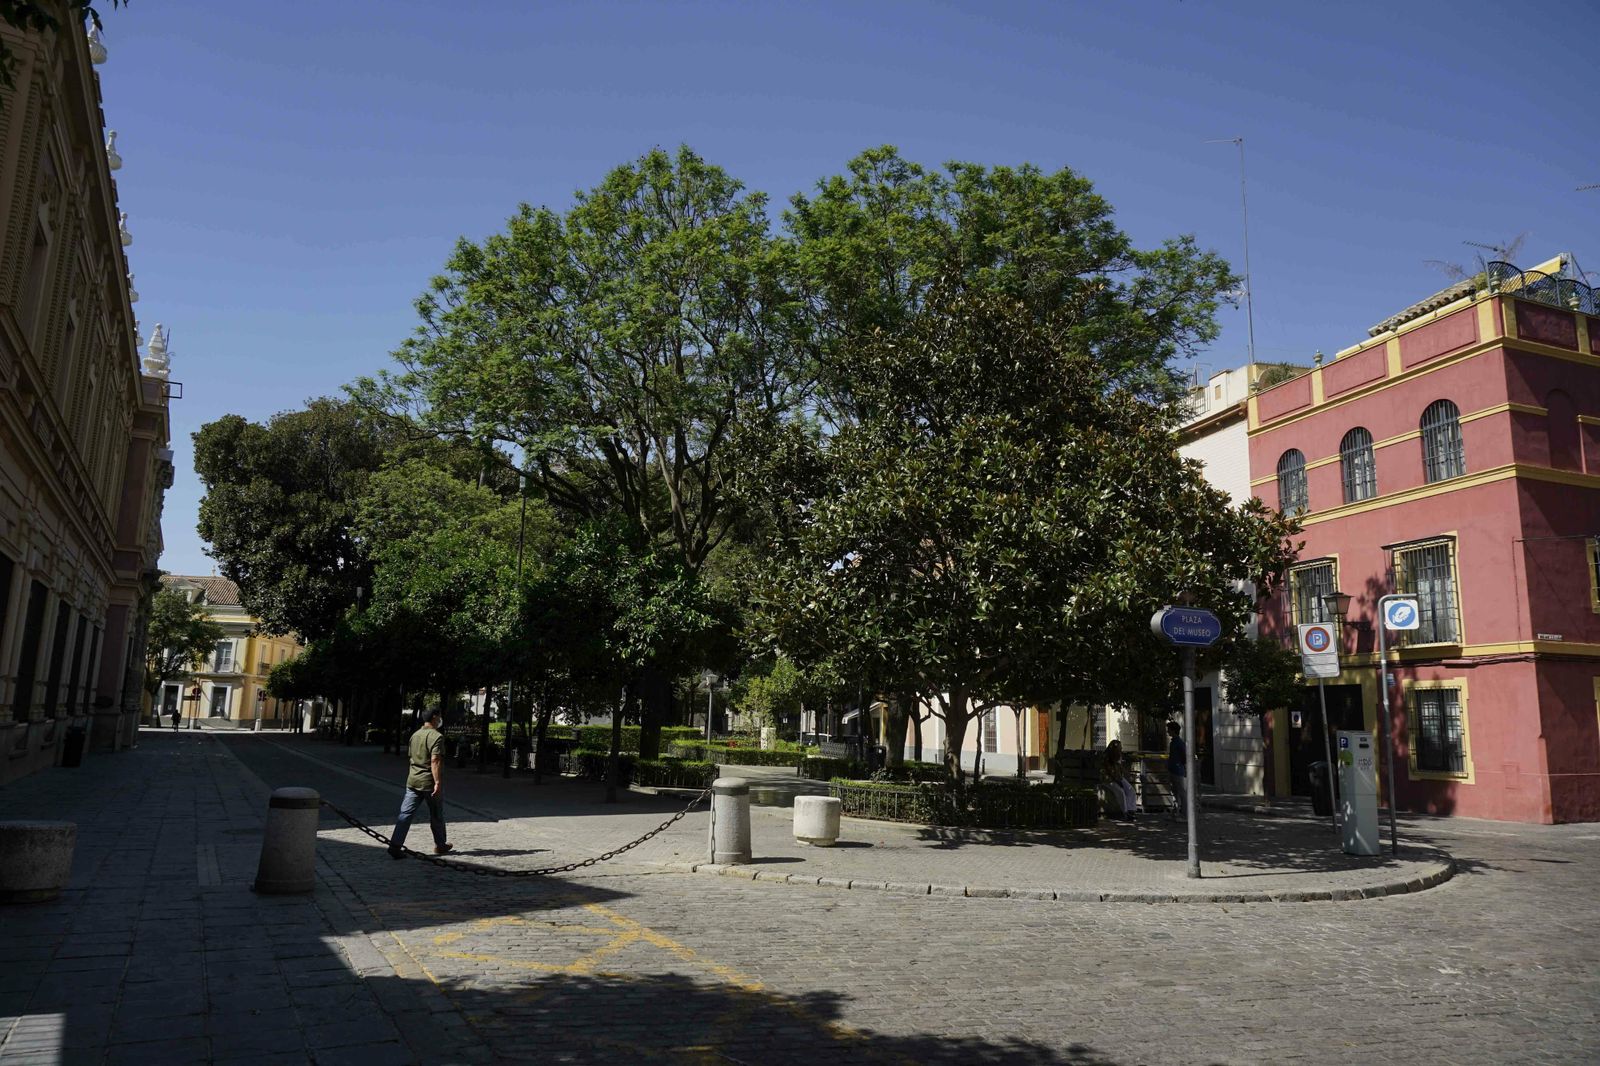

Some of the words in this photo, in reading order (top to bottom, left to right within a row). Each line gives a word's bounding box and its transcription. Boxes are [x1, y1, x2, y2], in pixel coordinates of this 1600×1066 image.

[1181, 615, 1203, 624] PLAZA
[1173, 627, 1186, 636] DEL
[1187, 628, 1211, 637] MUSEO
